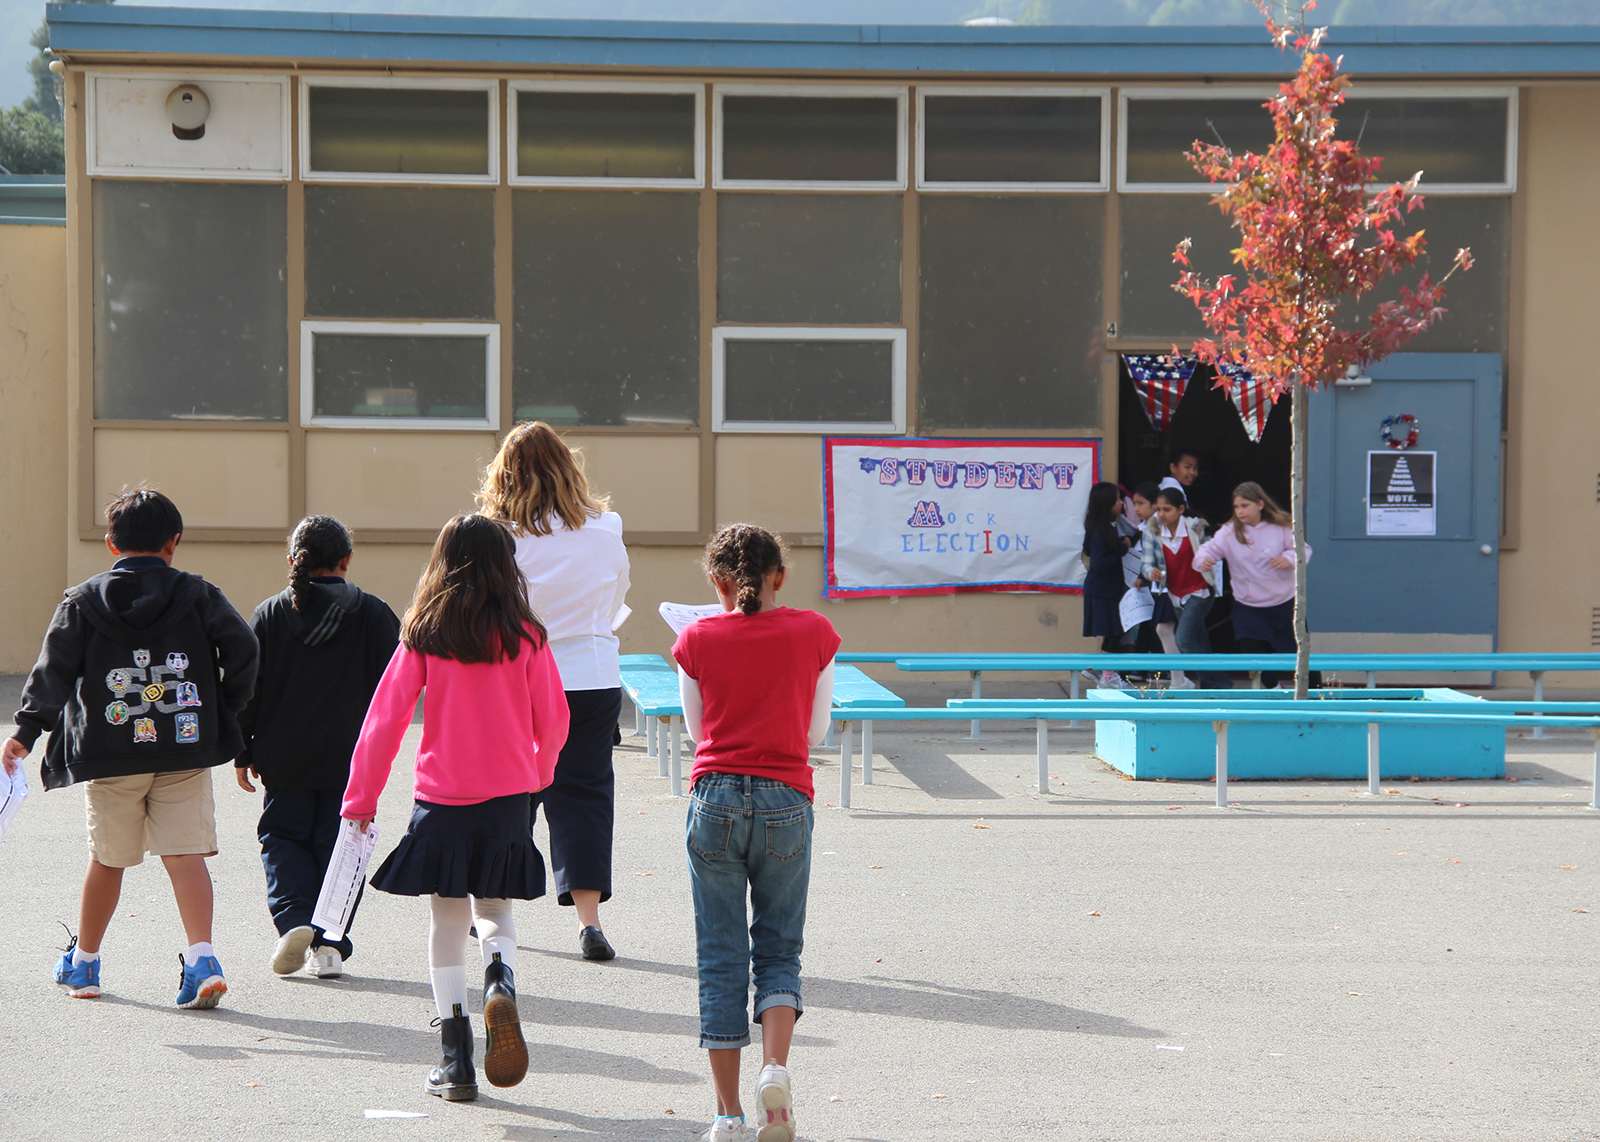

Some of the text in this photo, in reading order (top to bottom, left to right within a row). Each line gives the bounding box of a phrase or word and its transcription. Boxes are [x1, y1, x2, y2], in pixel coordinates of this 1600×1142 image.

[1107, 322, 1116, 336] 4
[879, 457, 1075, 490] STUDENT
[1387, 494, 1417, 503] VOTE.
[907, 500, 997, 528] MOCK
[901, 530, 1030, 554] ELECTION
